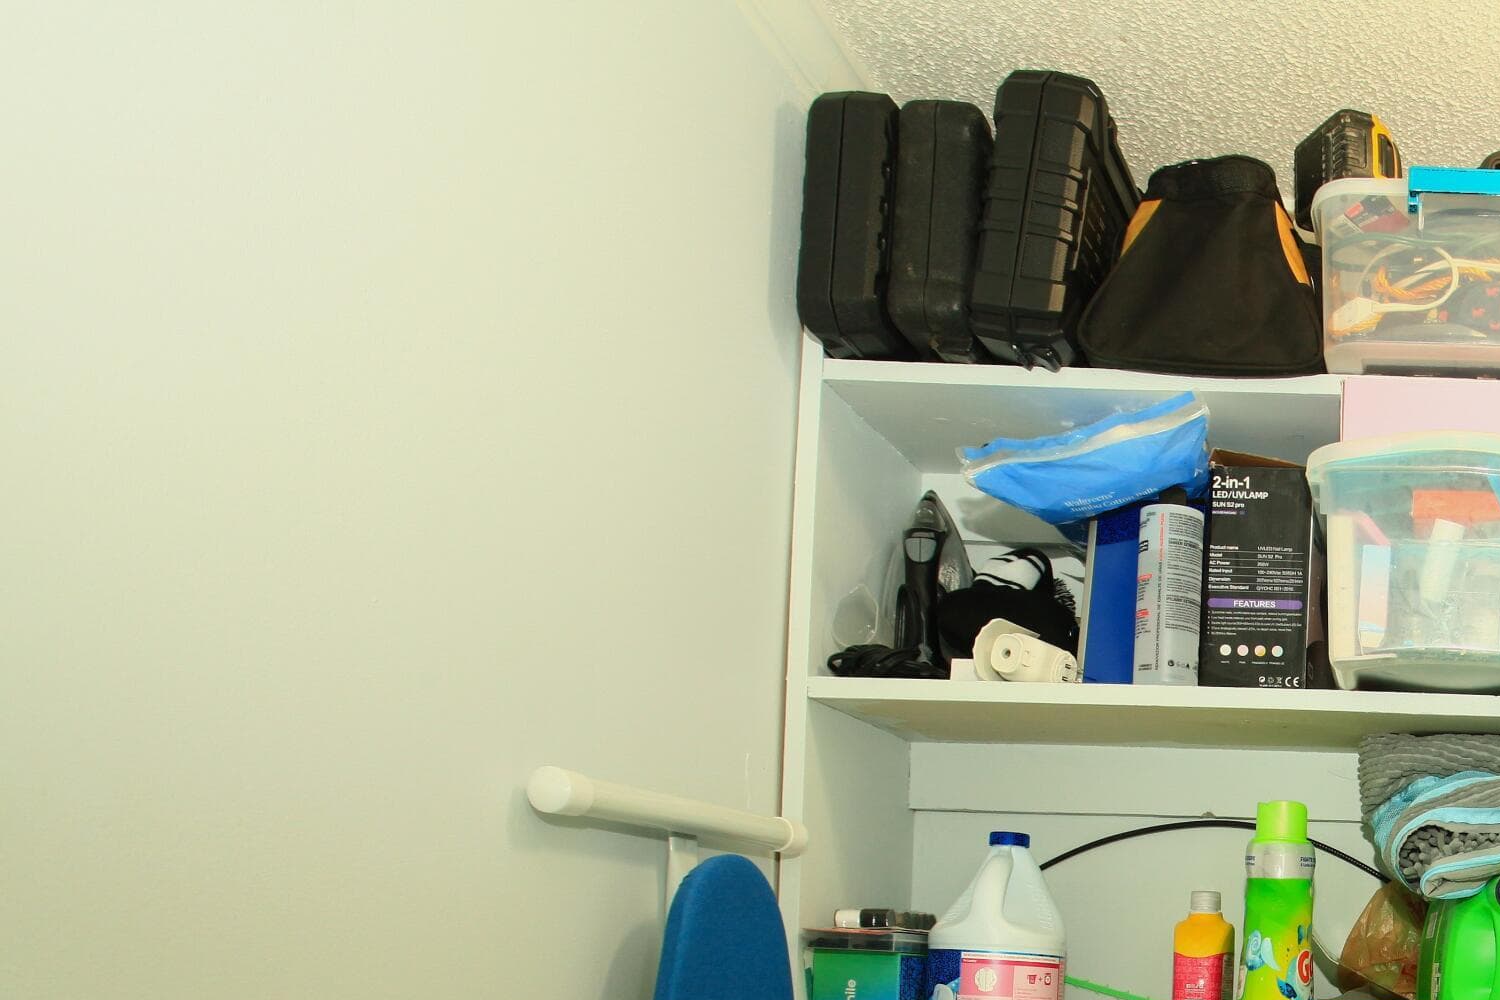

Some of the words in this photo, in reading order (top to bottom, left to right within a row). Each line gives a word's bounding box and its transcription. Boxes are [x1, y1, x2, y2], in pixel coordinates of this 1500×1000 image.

[1212, 476, 1250, 489] 2-in-1
[1212, 491, 1269, 499] LED/UVLAMP
[1103, 496, 1134, 507] Cotton
[1233, 600, 1276, 608] FEATURES
